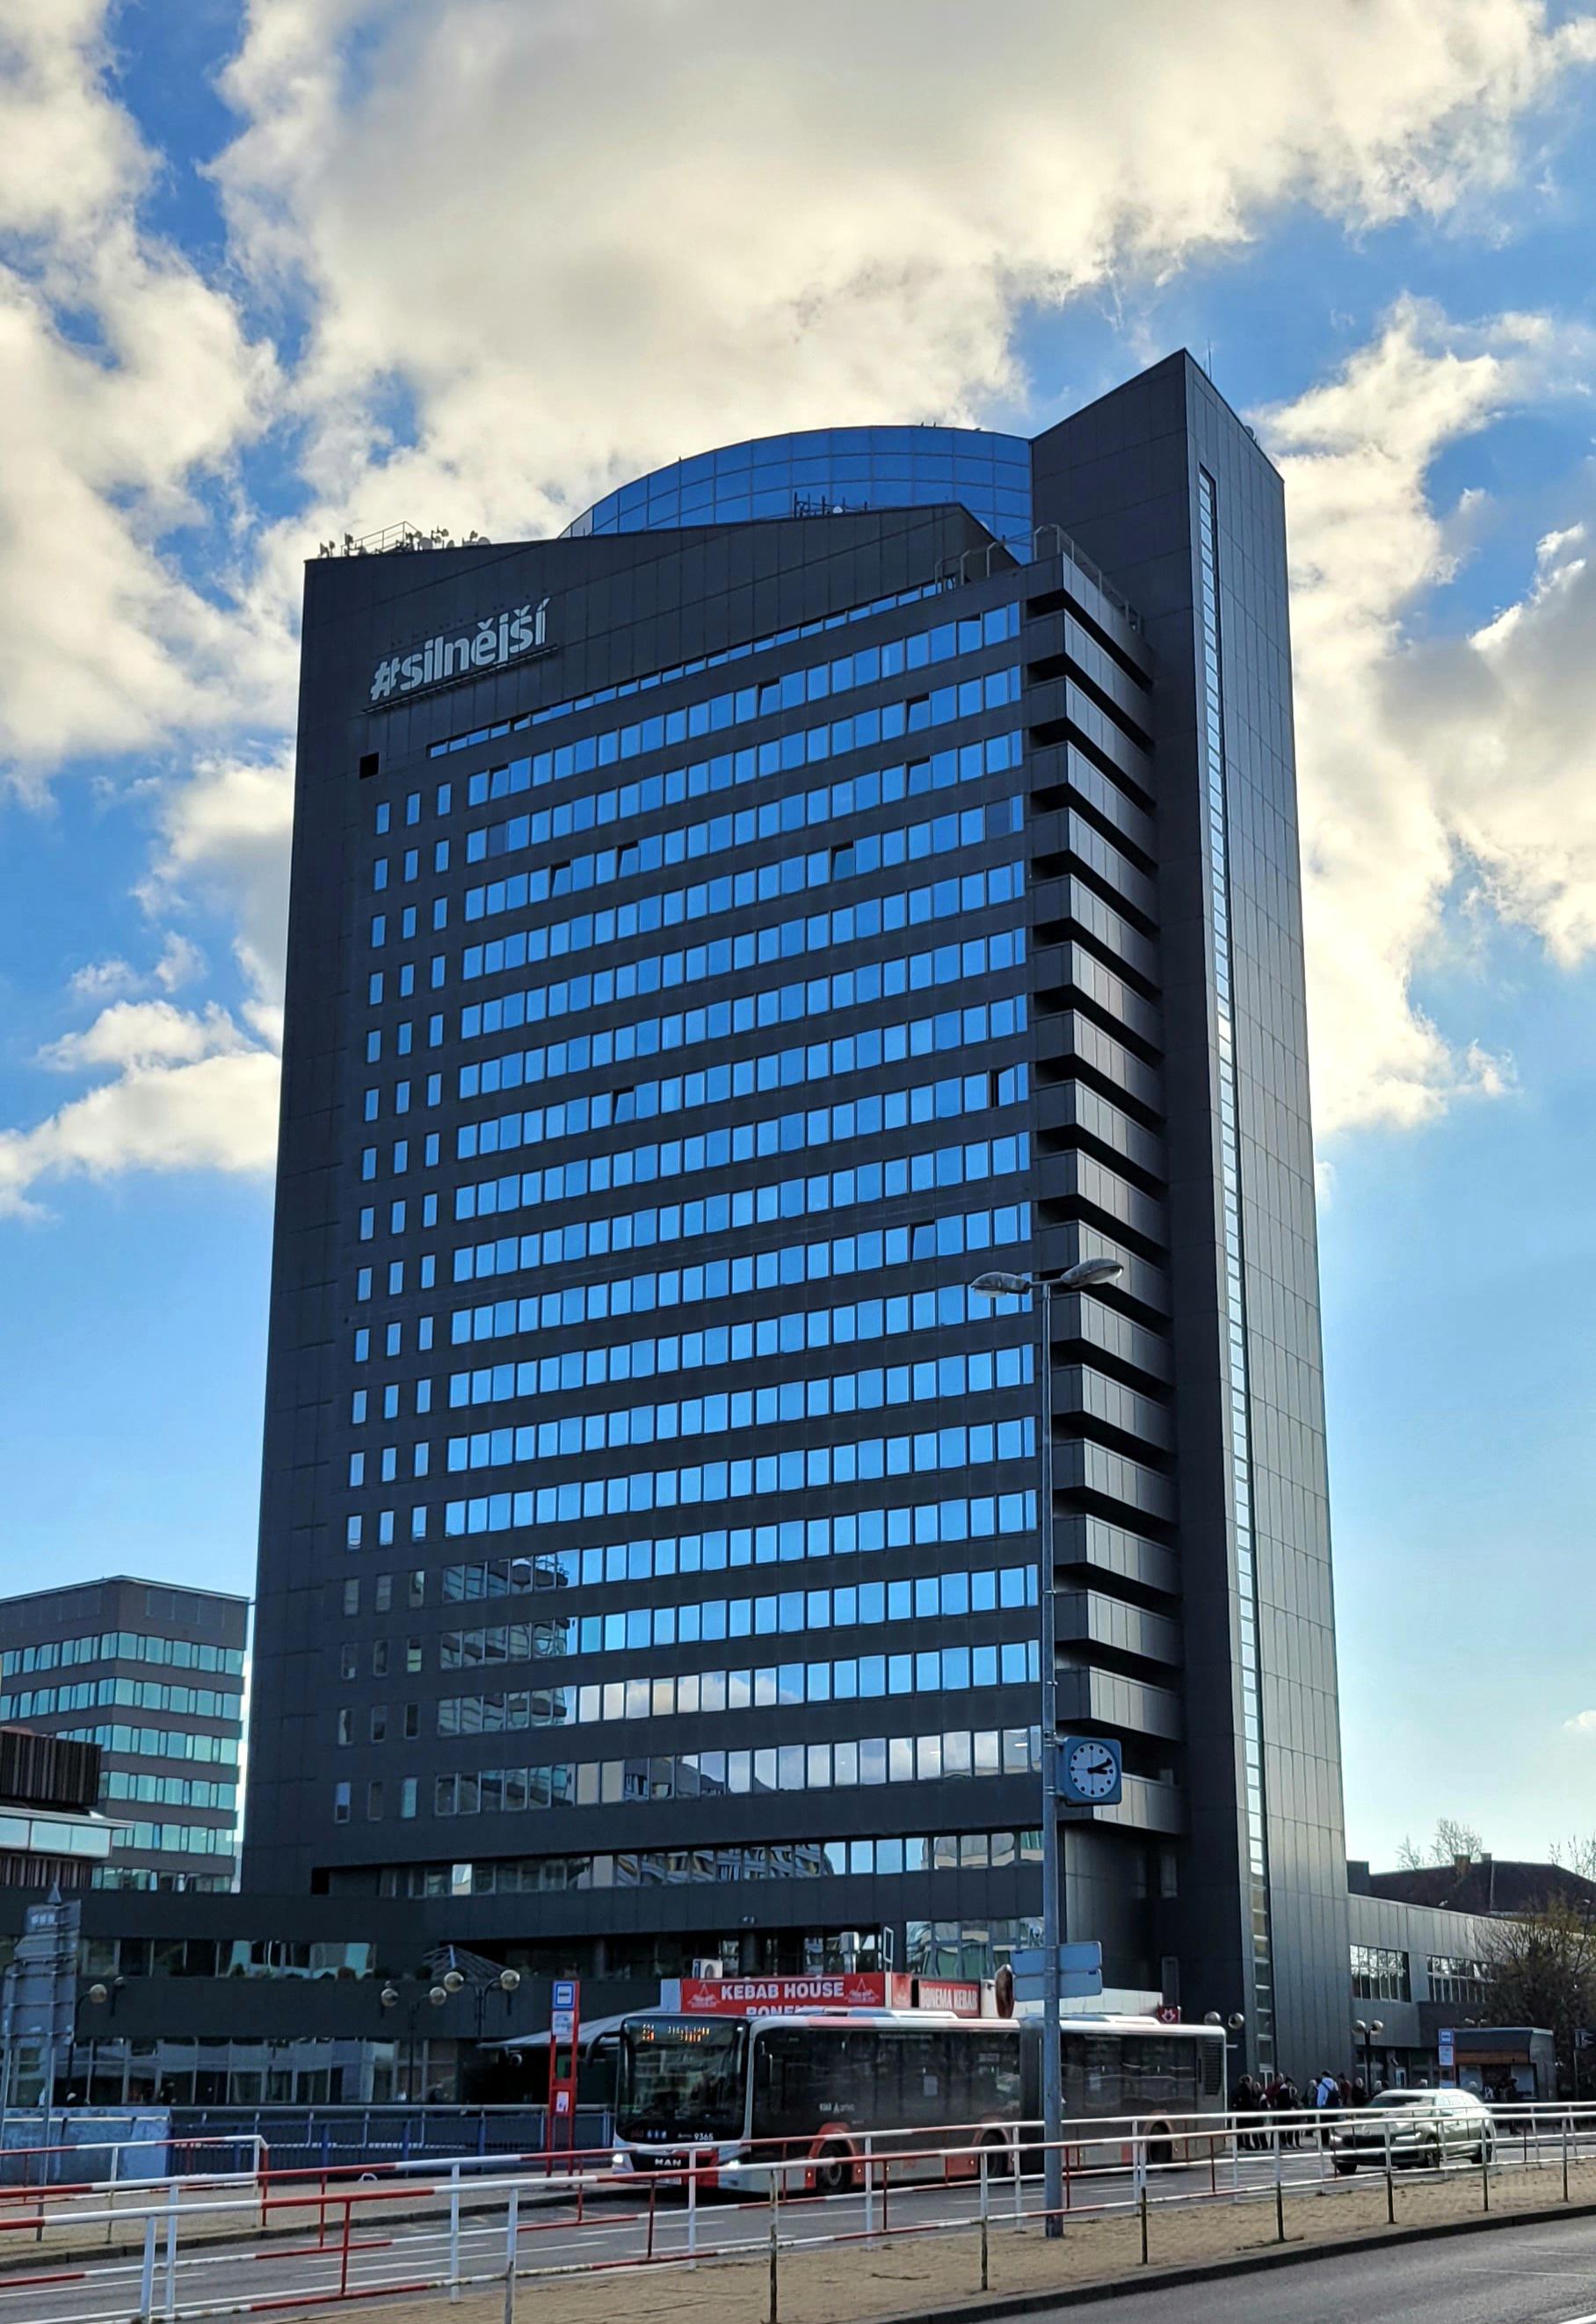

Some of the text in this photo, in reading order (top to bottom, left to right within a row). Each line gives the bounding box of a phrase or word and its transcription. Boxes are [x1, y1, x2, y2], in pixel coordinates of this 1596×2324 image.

[370, 598, 550, 701] #silnější
[721, 1984, 780, 2001] KEBAB
[784, 1981, 845, 1999] HOUSE
[954, 1988, 978, 2011] KEBAB
[693, 2132, 714, 2141] 9365
[655, 2158, 681, 2167] MAN
